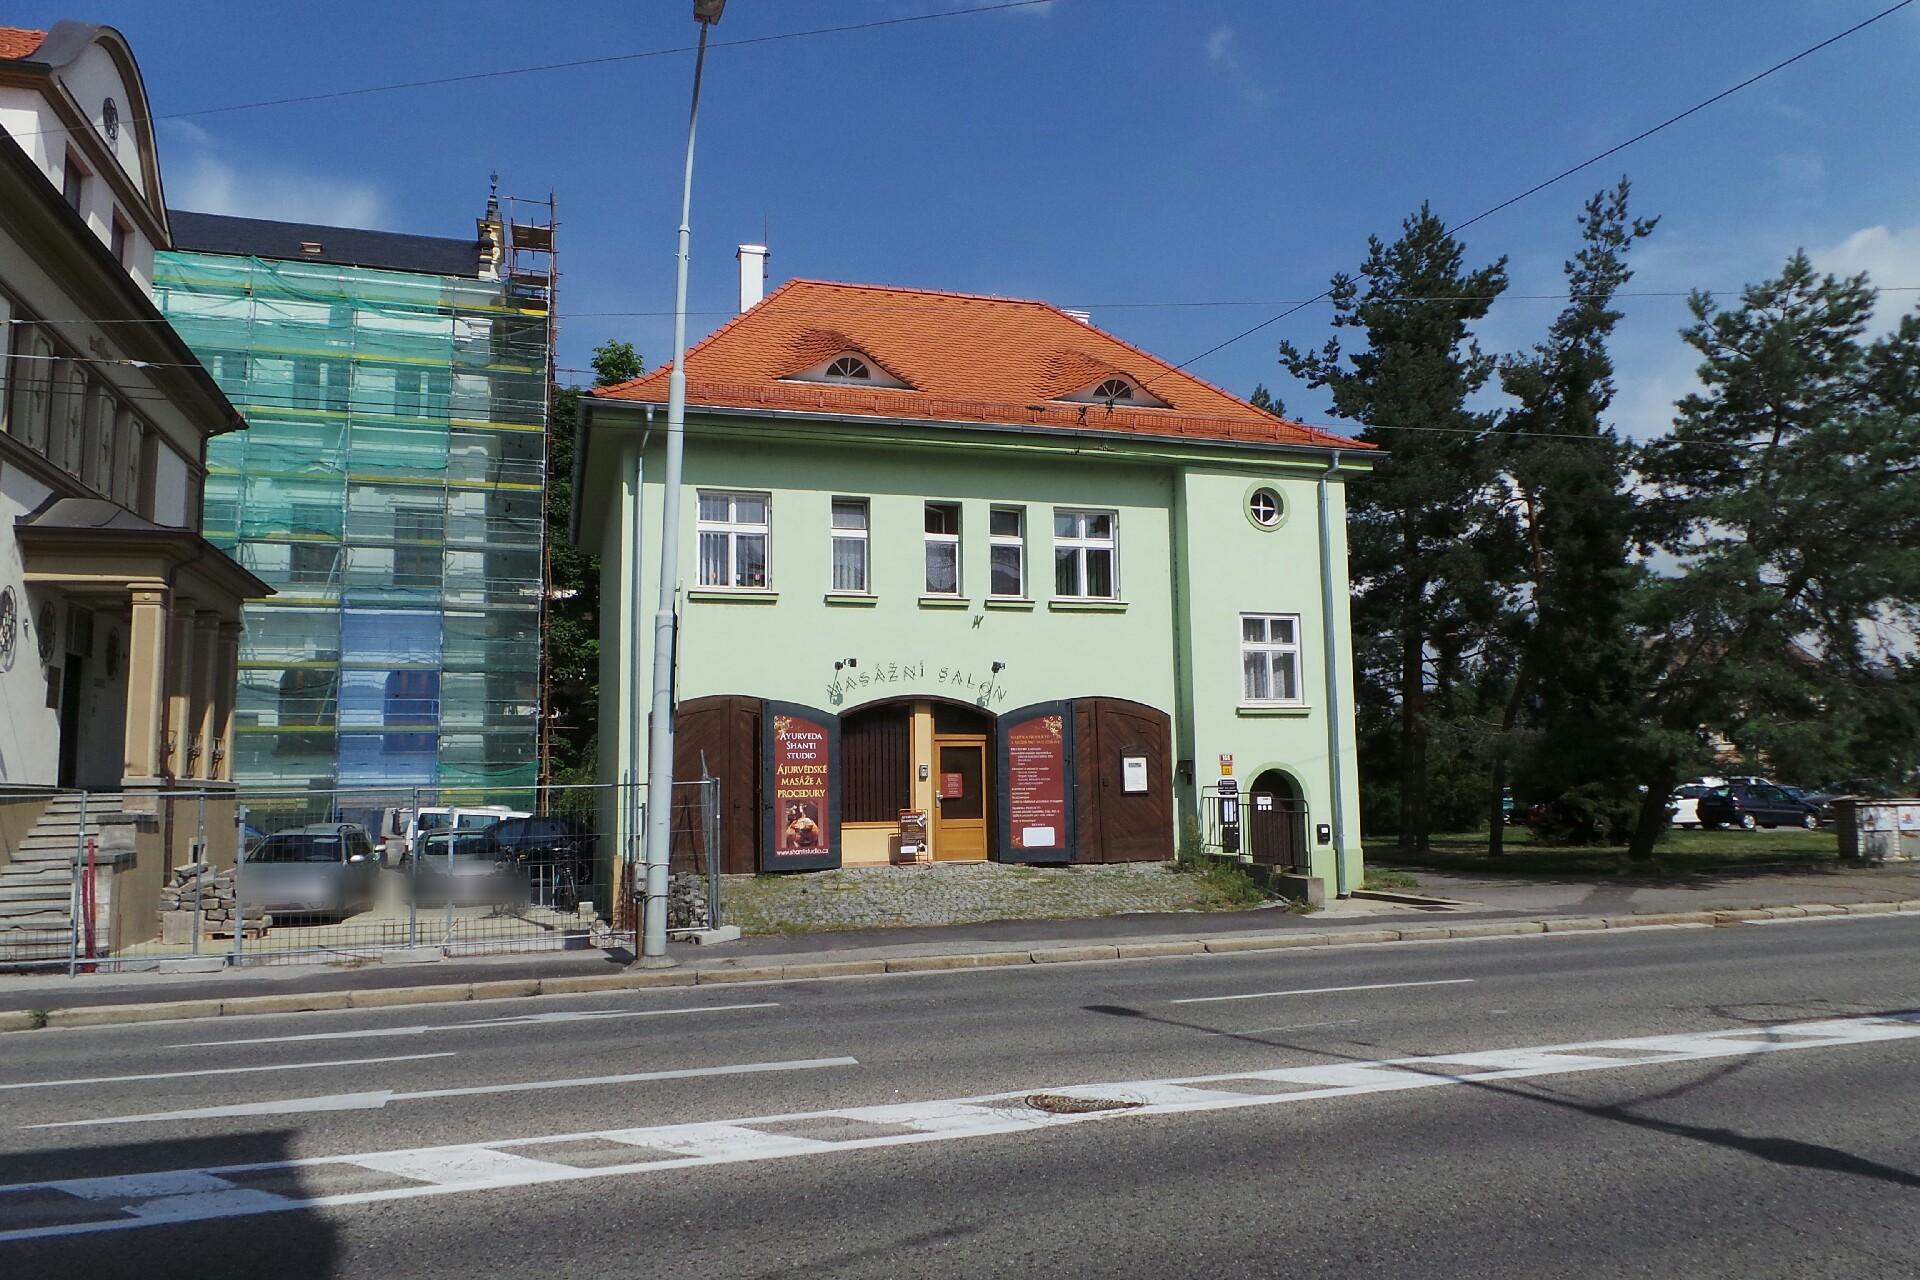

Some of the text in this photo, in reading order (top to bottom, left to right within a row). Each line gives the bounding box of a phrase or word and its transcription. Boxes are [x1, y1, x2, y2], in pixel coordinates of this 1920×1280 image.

[826, 660, 1007, 703] MASÁŽNÍ SALON
[780, 732, 823, 740] AYURVEDA
[786, 741, 817, 749] SHANTI
[781, 775, 822, 785] MASÁŽE A
[777, 789, 826, 798] PROCEDURY
